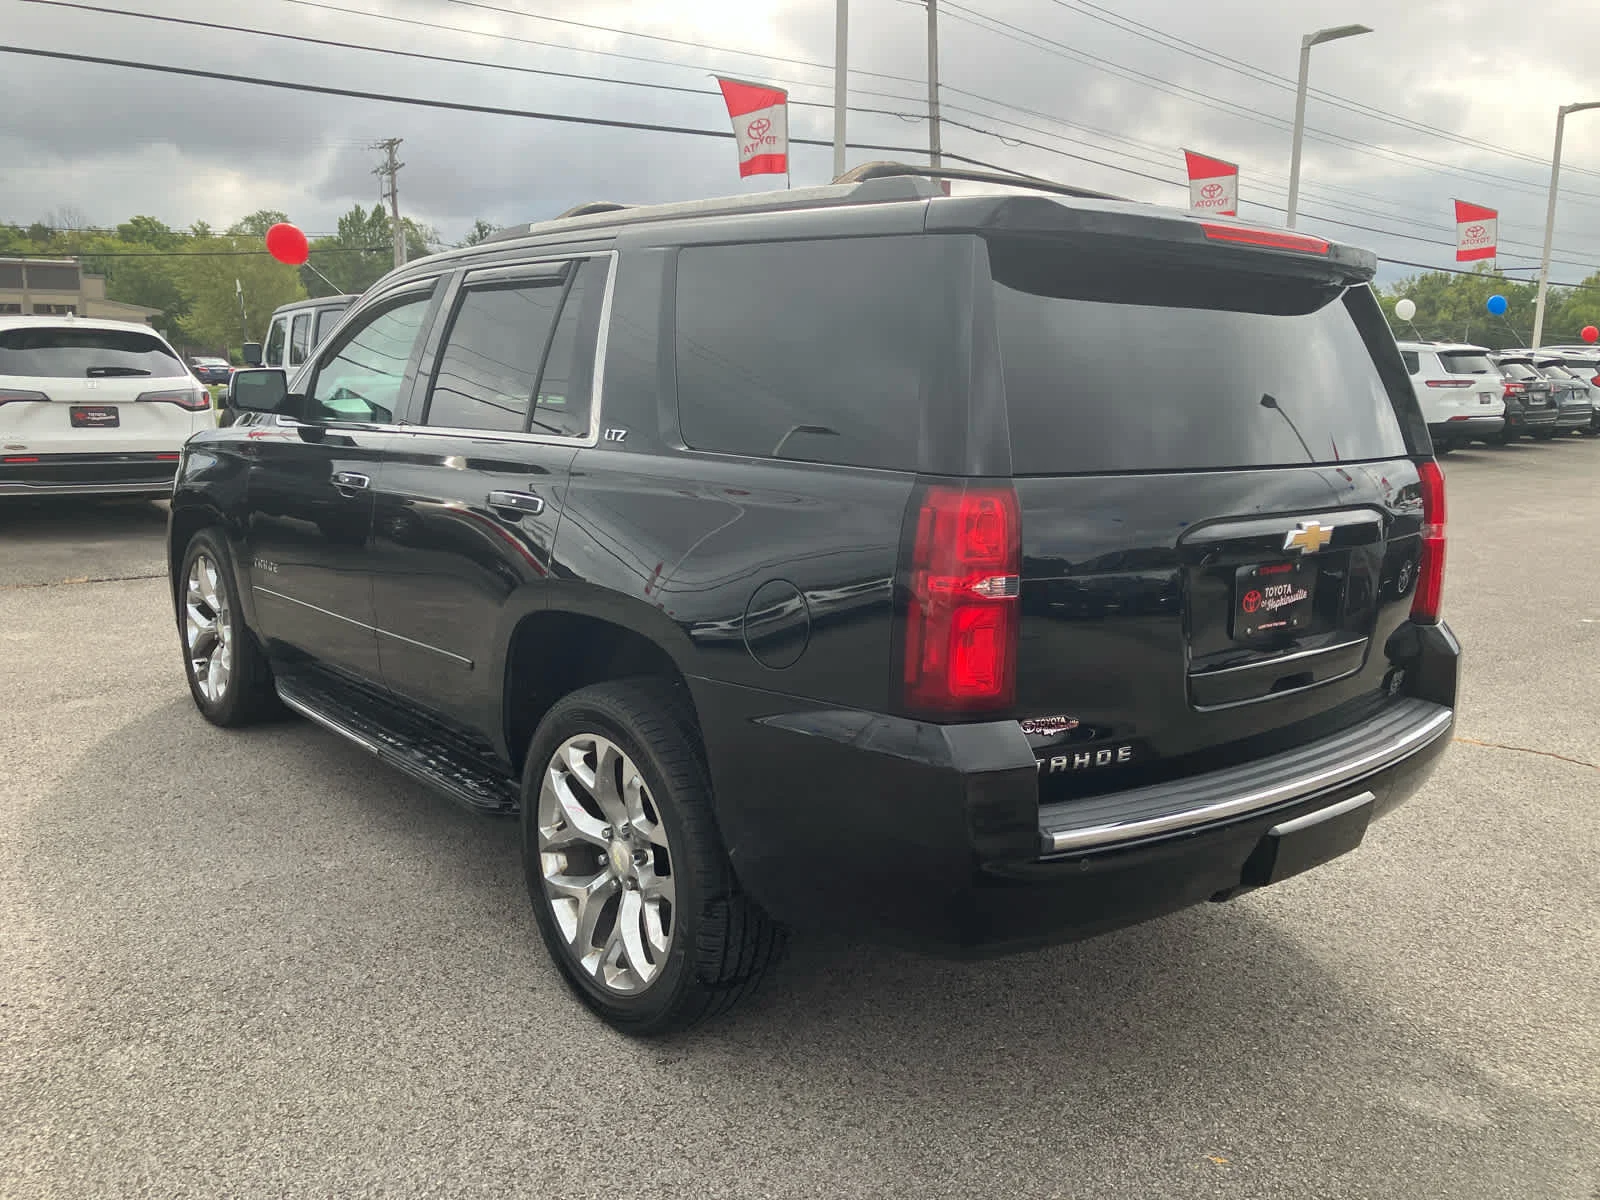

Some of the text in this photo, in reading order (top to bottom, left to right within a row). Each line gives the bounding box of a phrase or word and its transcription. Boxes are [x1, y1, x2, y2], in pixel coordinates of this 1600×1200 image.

[604, 428, 628, 442] LTZ
[1265, 584, 1292, 598] TOYOTA
[1035, 716, 1066, 726] TOYOTA
[1035, 745, 1133, 774] TAHOE
